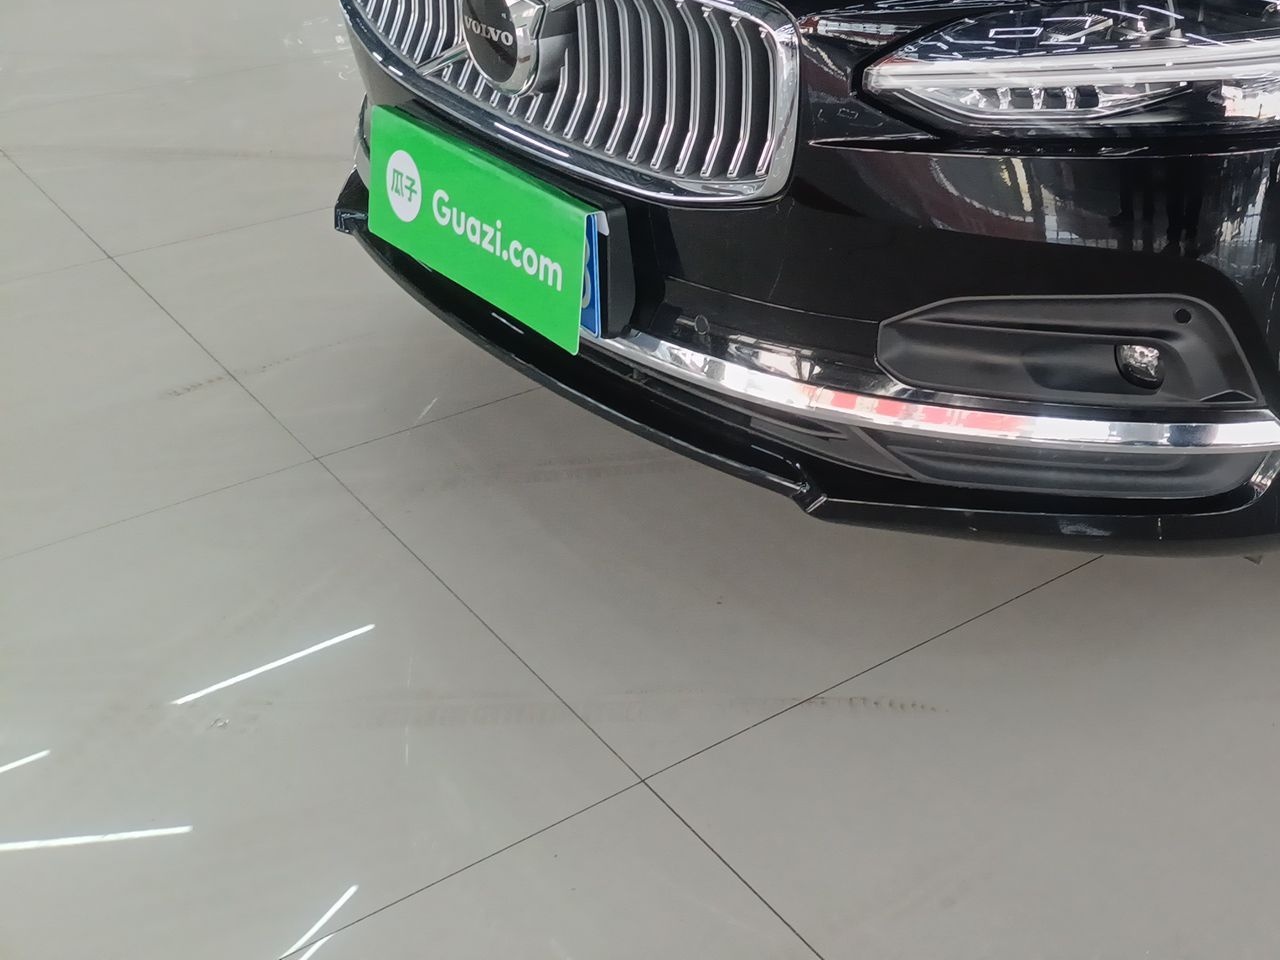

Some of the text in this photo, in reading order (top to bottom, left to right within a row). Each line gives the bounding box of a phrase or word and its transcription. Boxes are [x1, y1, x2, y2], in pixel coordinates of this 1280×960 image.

[463, 15, 514, 46] VOLVO
[391, 167, 418, 203] 瓜子
[432, 188, 563, 292] Guazi.com
